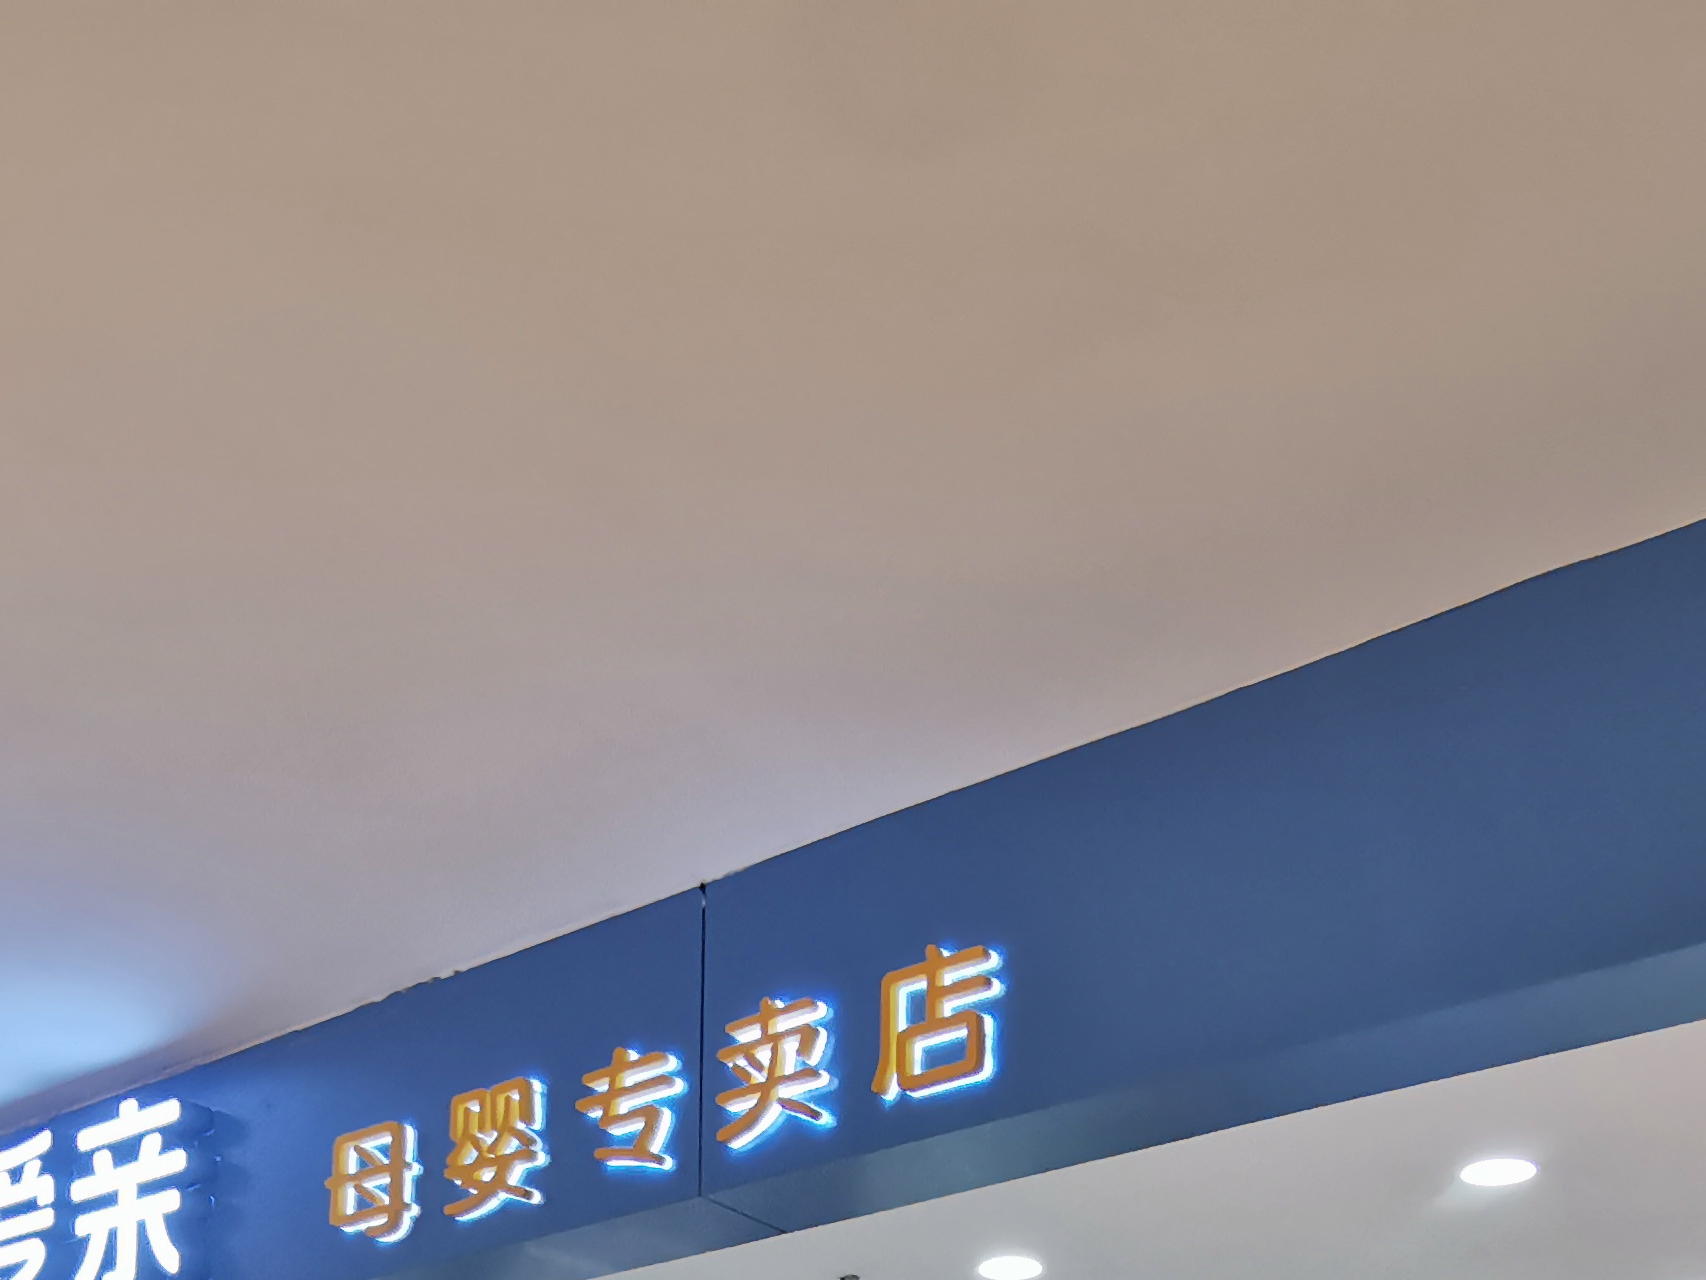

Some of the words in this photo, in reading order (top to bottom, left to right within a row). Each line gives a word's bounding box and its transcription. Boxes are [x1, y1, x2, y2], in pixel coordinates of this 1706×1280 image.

[323, 943, 1005, 1243] 母婴专卖店
